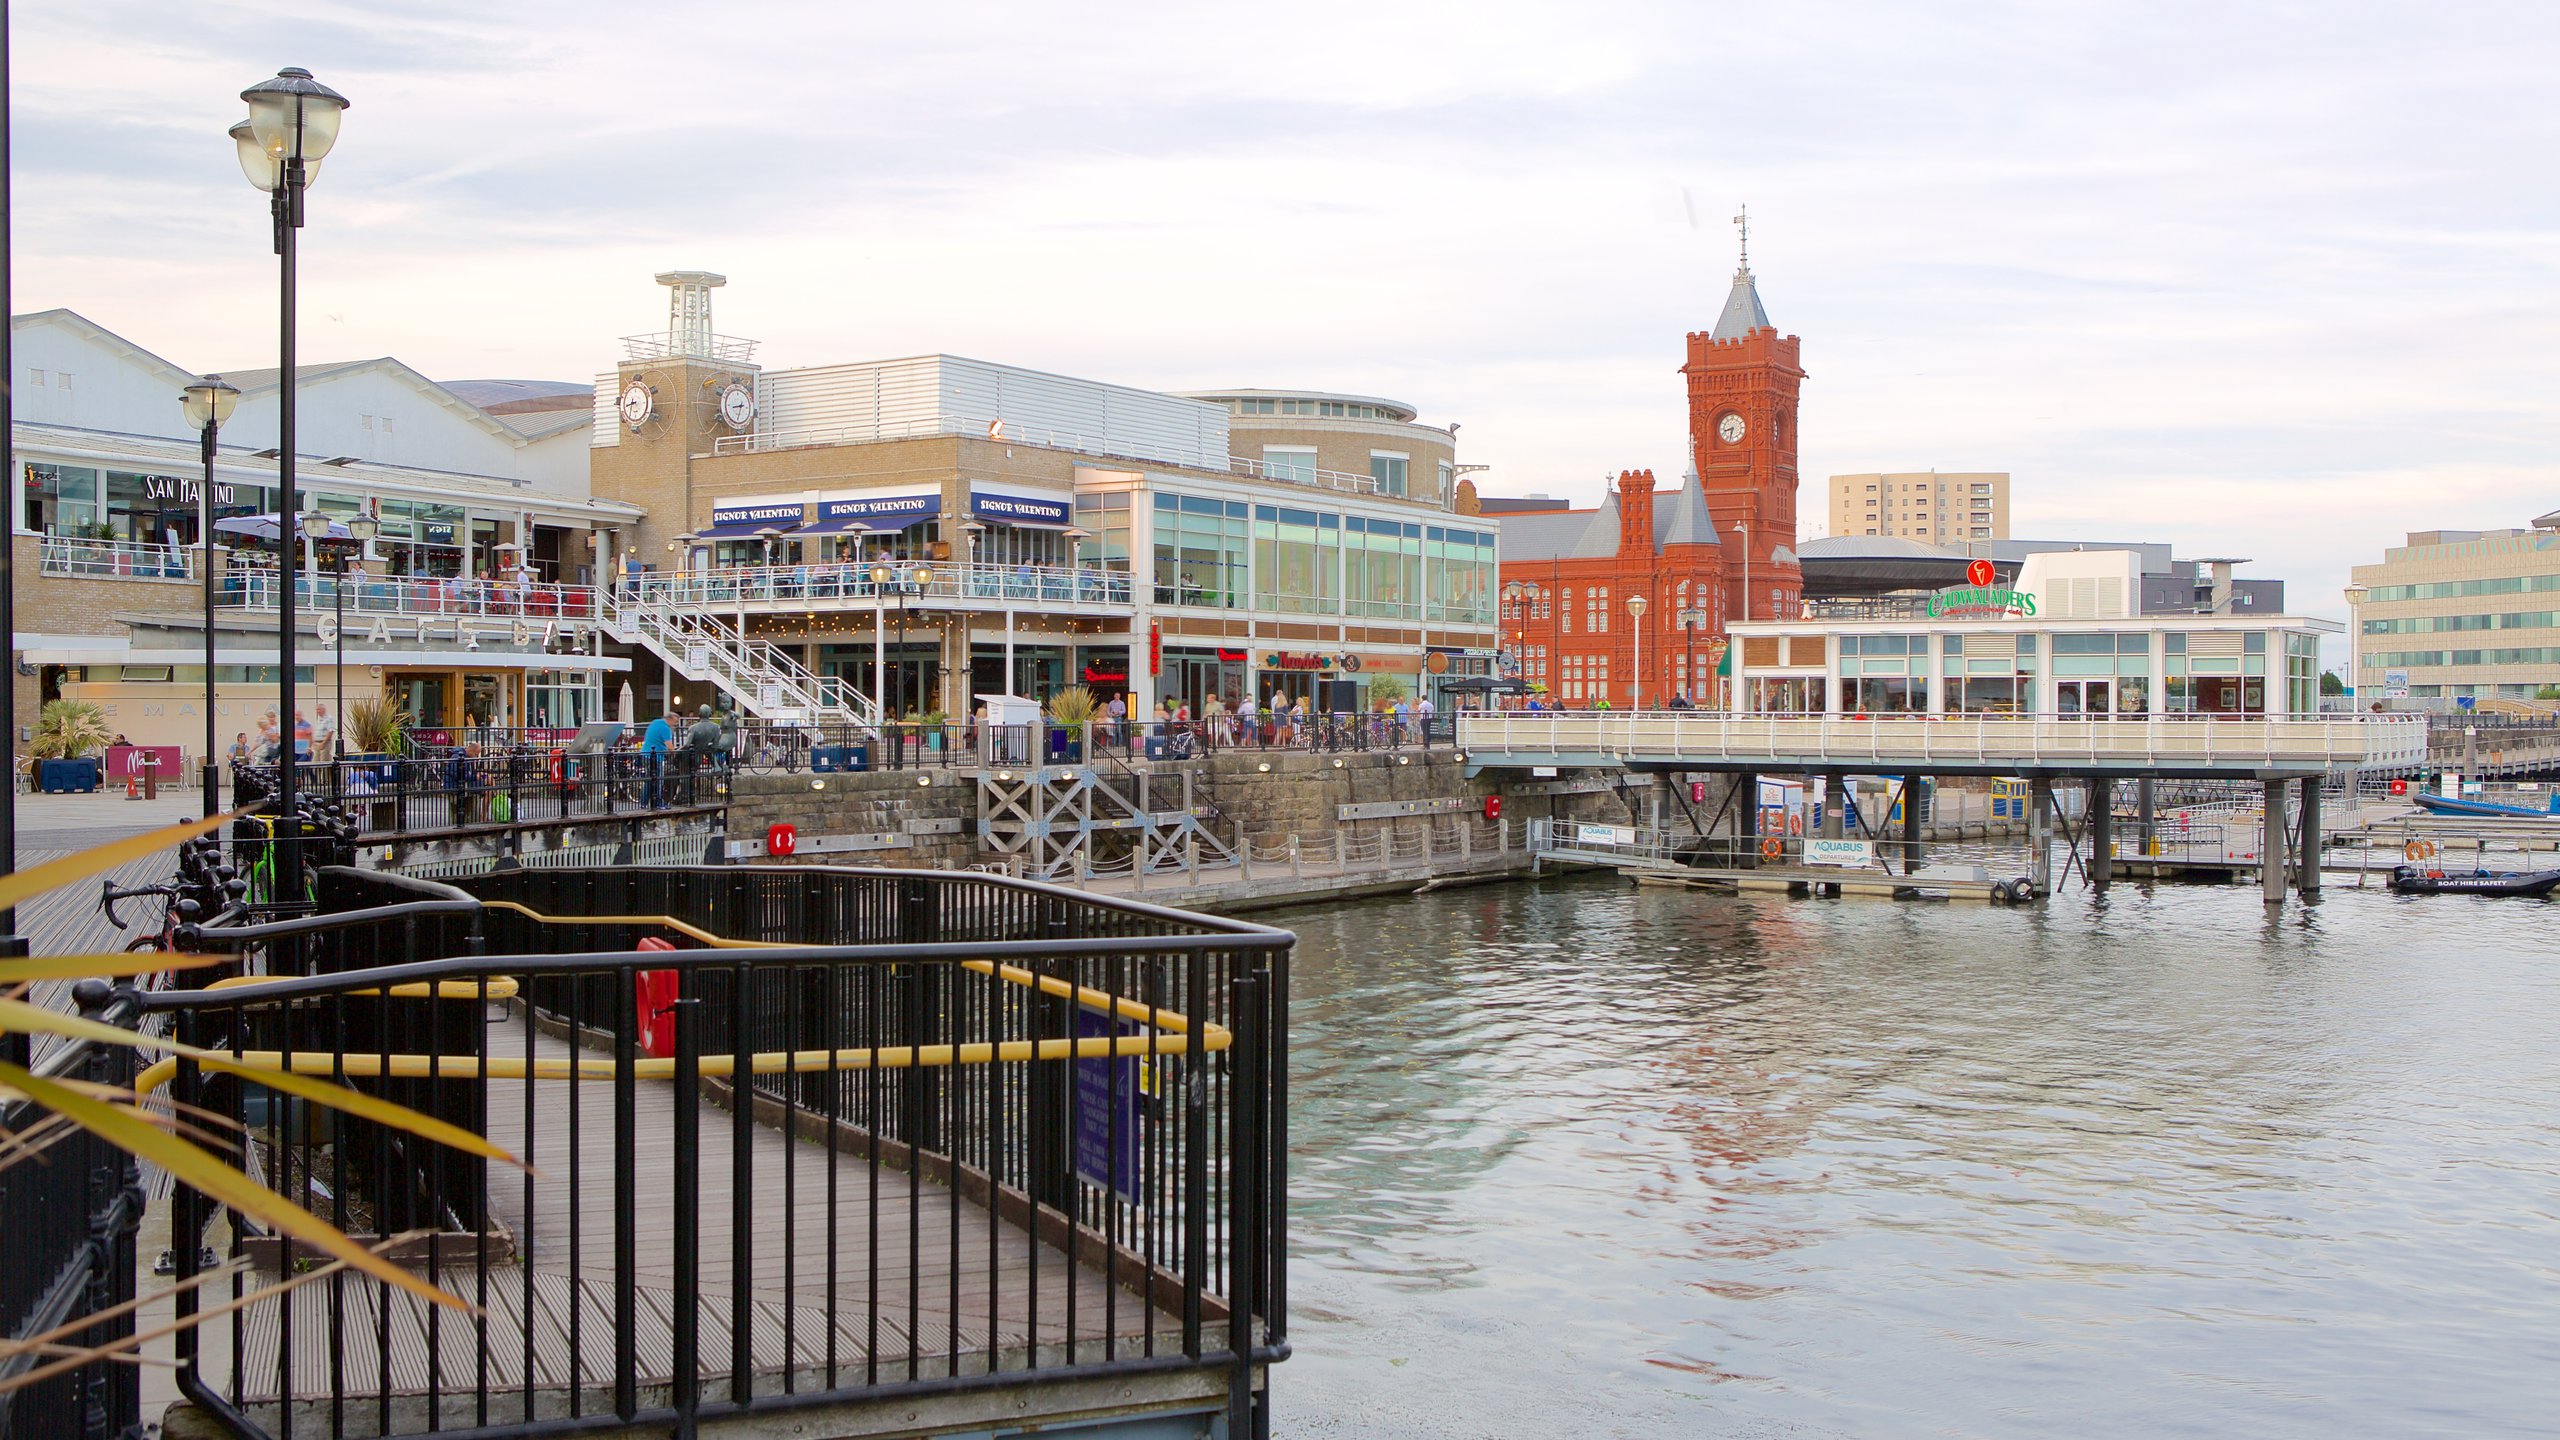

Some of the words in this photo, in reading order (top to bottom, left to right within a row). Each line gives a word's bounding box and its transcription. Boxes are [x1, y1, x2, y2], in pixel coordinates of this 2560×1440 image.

[146, 475, 174, 500] SAN
[180, 478, 234, 504] MAINO
[714, 511, 748, 521] SIGNOR
[750, 507, 801, 520] VALENTINO
[831, 503, 867, 514] SIGNOR
[869, 499, 925, 513] VALENTINO
[980, 500, 1013, 512] SIGNOR
[1014, 503, 1062, 517] VALENTINO
[1927, 588, 2037, 617] CADWALADERS
[1278, 651, 1324, 669] Nando's
[1583, 827, 1613, 836] AQUABUS
[1814, 841, 1863, 852] AQUABUS
